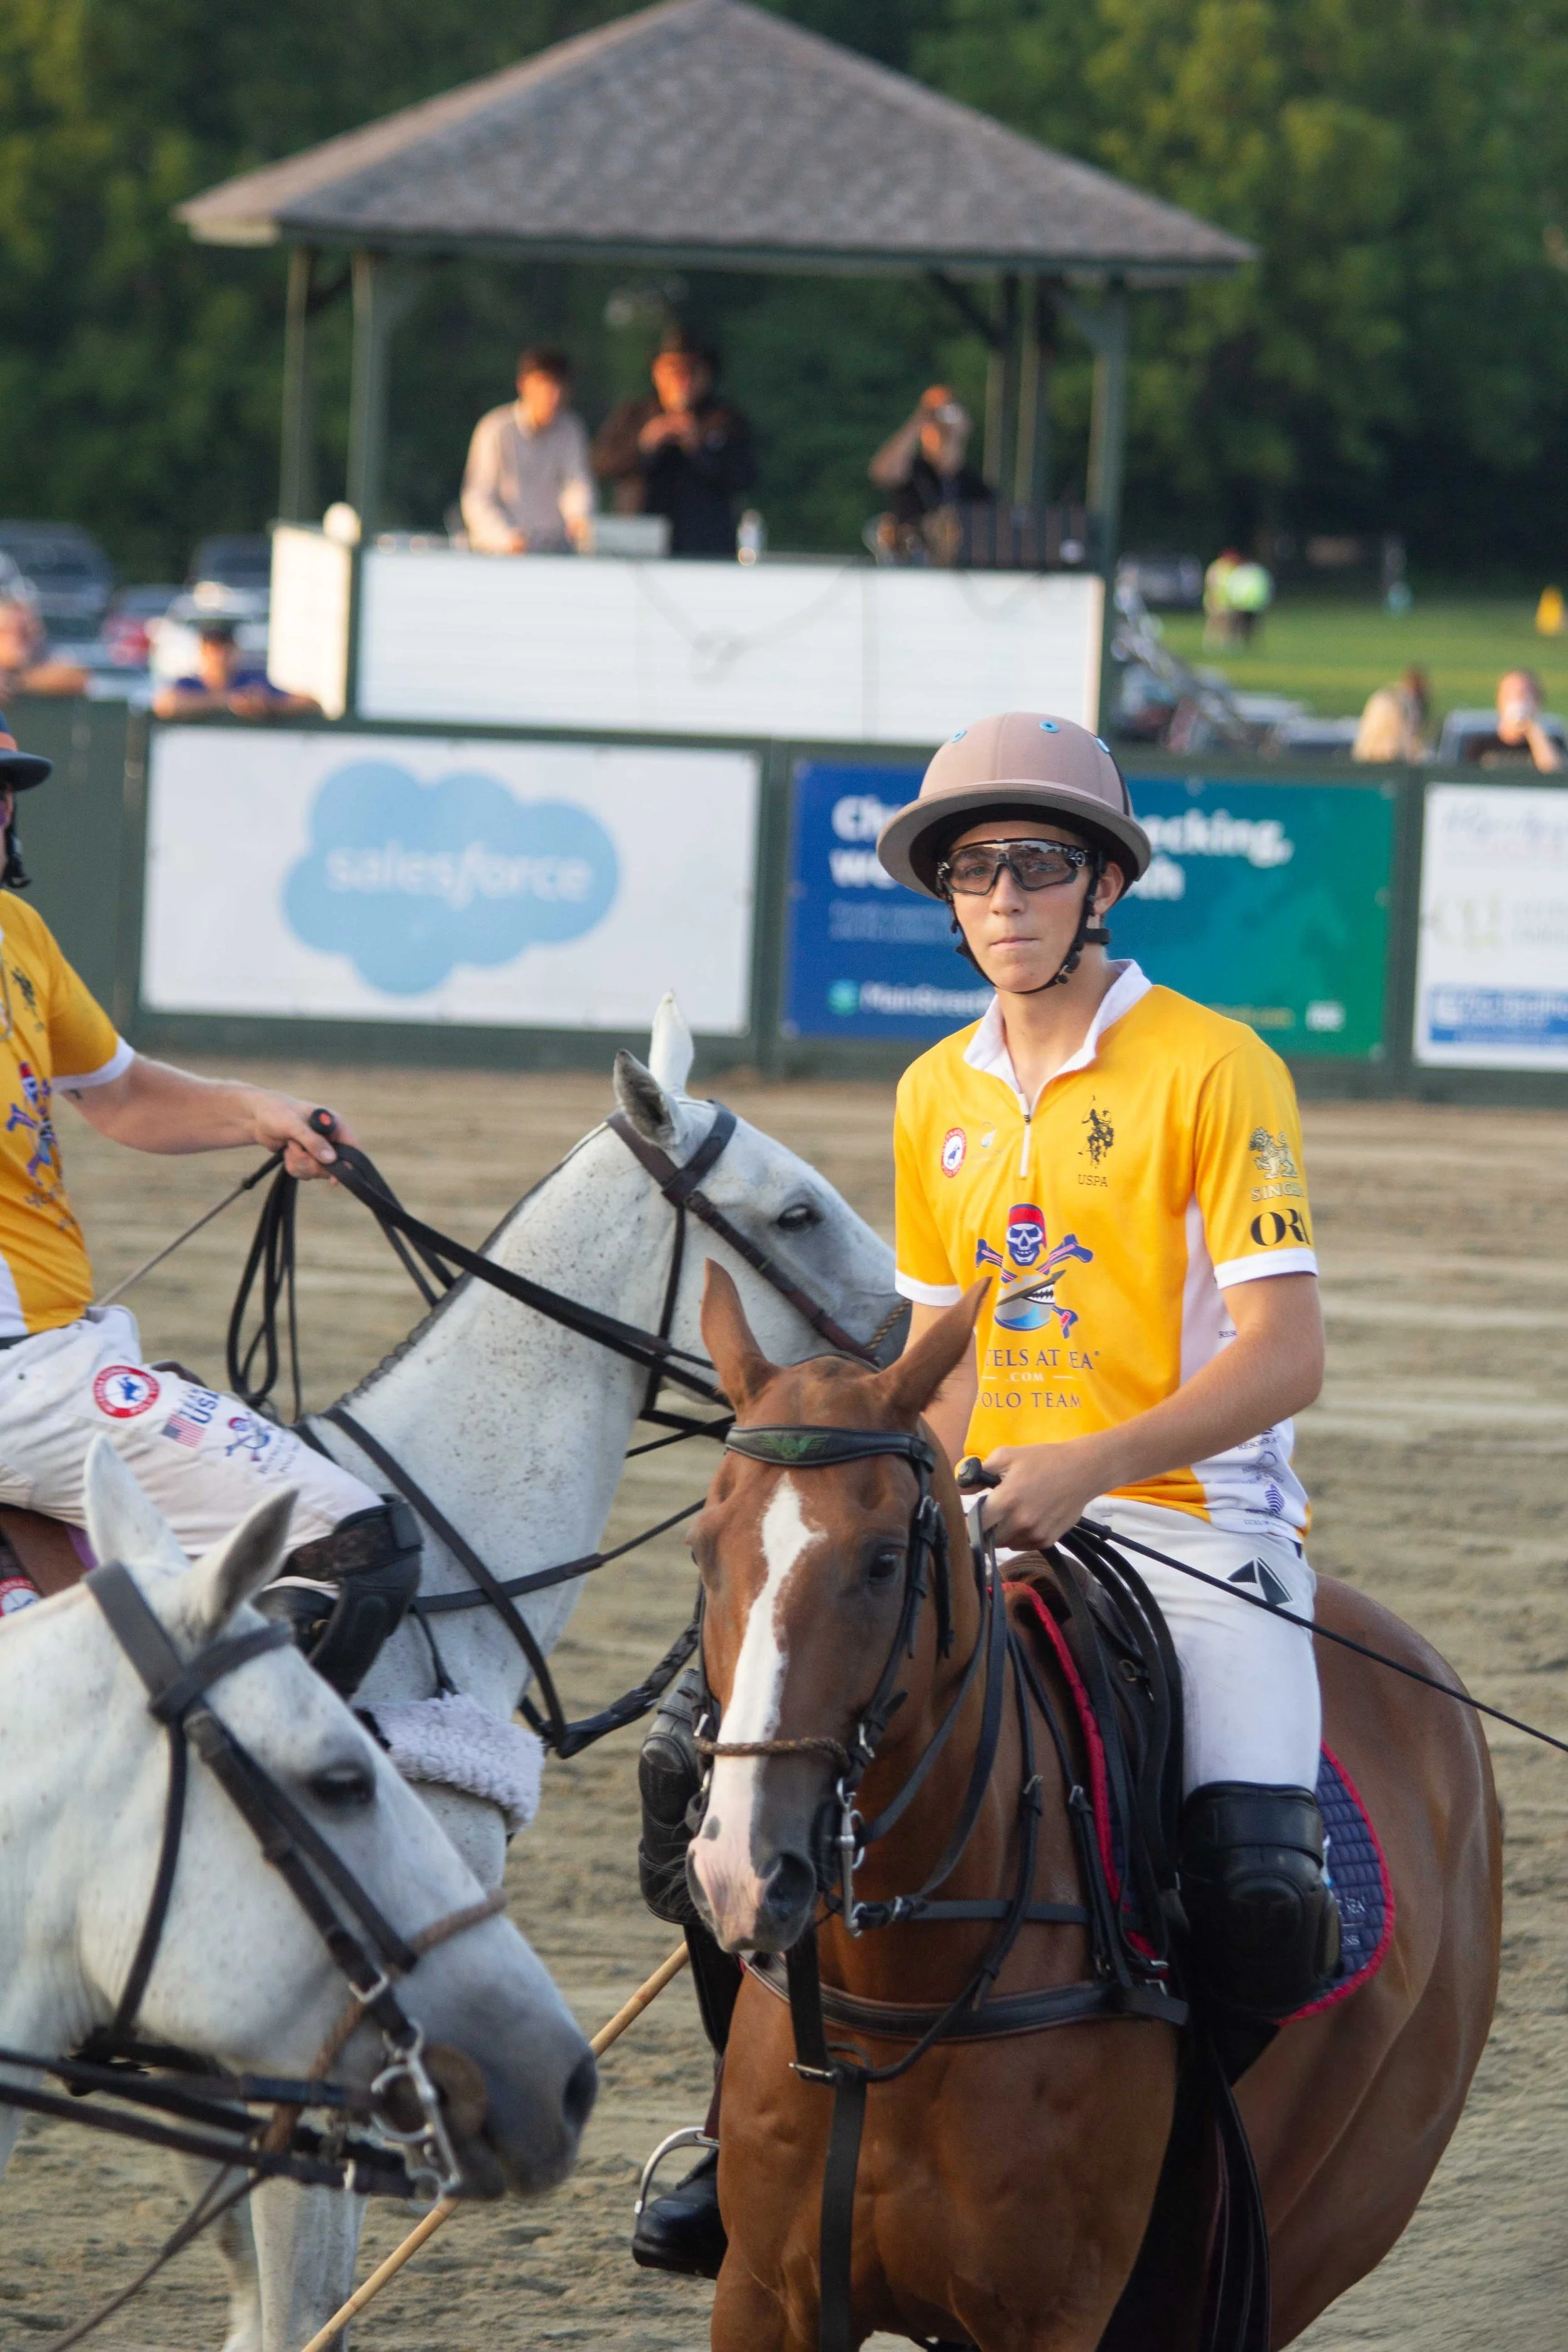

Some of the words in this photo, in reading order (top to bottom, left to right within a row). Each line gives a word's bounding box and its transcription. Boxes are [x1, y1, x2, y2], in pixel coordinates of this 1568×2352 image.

[832, 795, 902, 842] Ch
[1130, 808, 1293, 867] ecking,
[326, 840, 591, 911] salesforce
[1078, 1174, 1108, 1187] USPA
[1036, 1349, 1061, 1366] AT
[1069, 1351, 1094, 1370] EA
[981, 1392, 1021, 1408] OLO
[1030, 1392, 1082, 1407] TEAM
